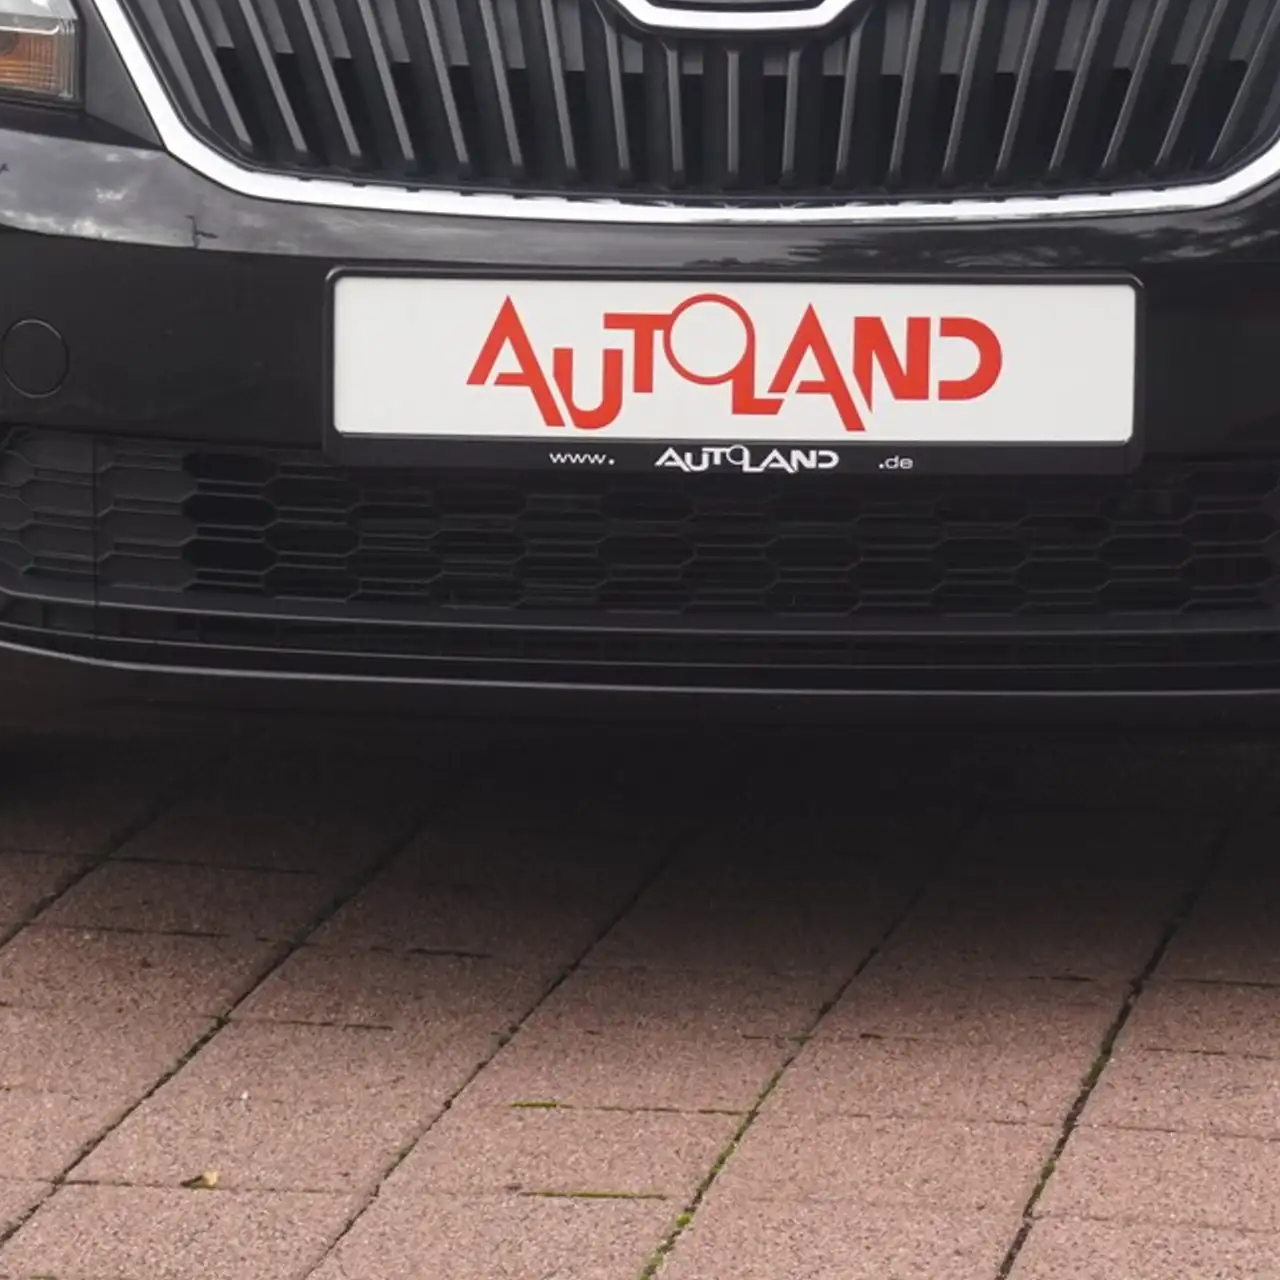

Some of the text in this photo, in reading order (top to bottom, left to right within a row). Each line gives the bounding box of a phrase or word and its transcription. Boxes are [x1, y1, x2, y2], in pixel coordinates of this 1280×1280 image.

[466, 293, 1002, 432] AUTOLAND
[548, 444, 913, 473] www. AUTOLAND .de
